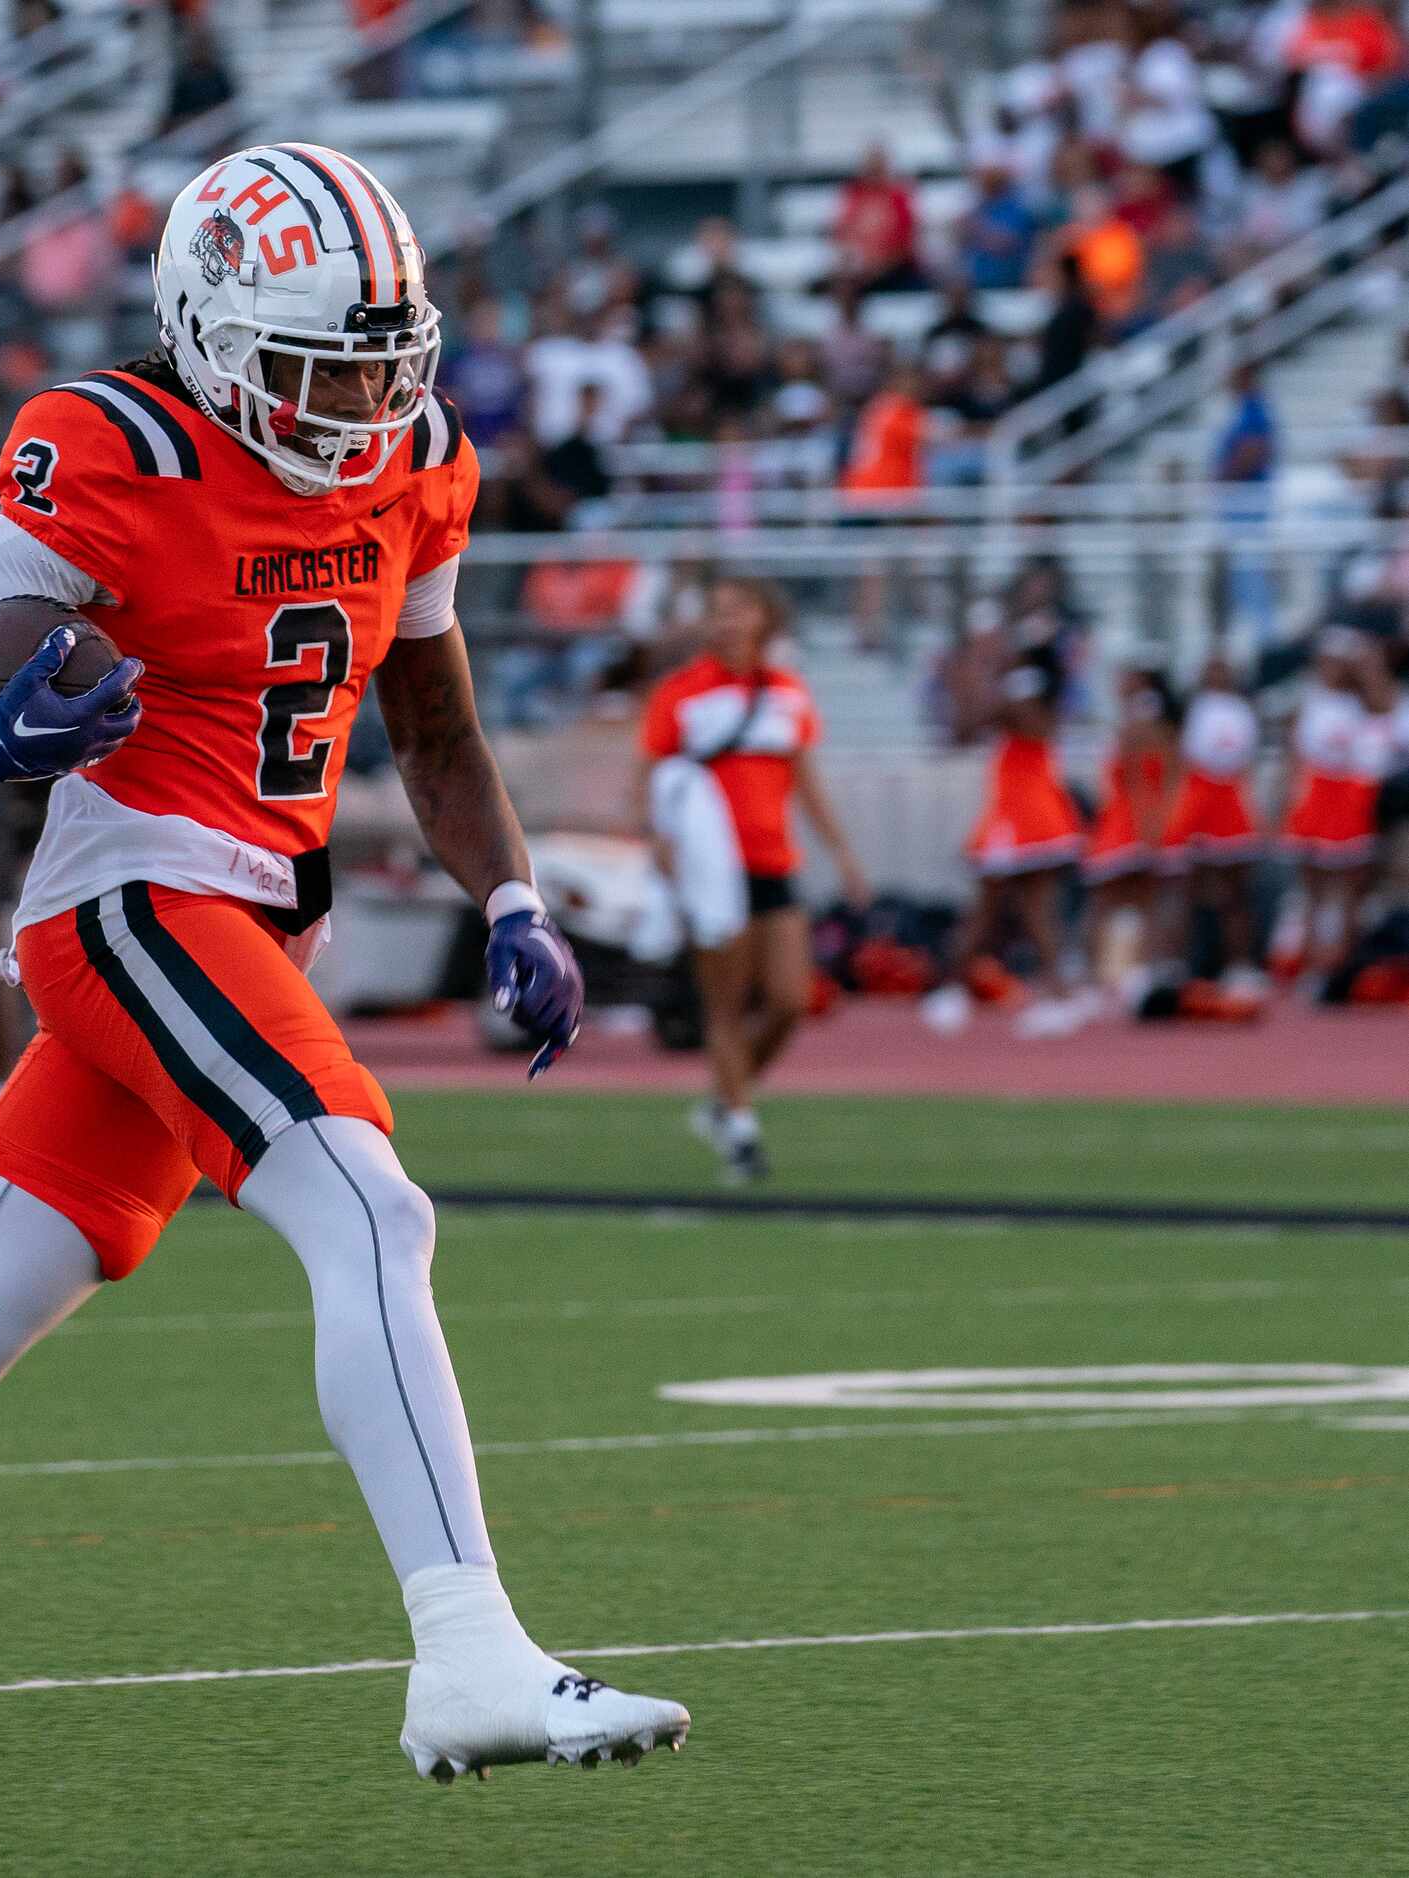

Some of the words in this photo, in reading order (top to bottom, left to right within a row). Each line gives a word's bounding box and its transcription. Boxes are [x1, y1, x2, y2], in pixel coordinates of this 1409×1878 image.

[195, 163, 319, 277] LHS
[11, 437, 60, 516] 2
[235, 540, 382, 597] LANCASTER
[256, 598, 353, 801] 2
